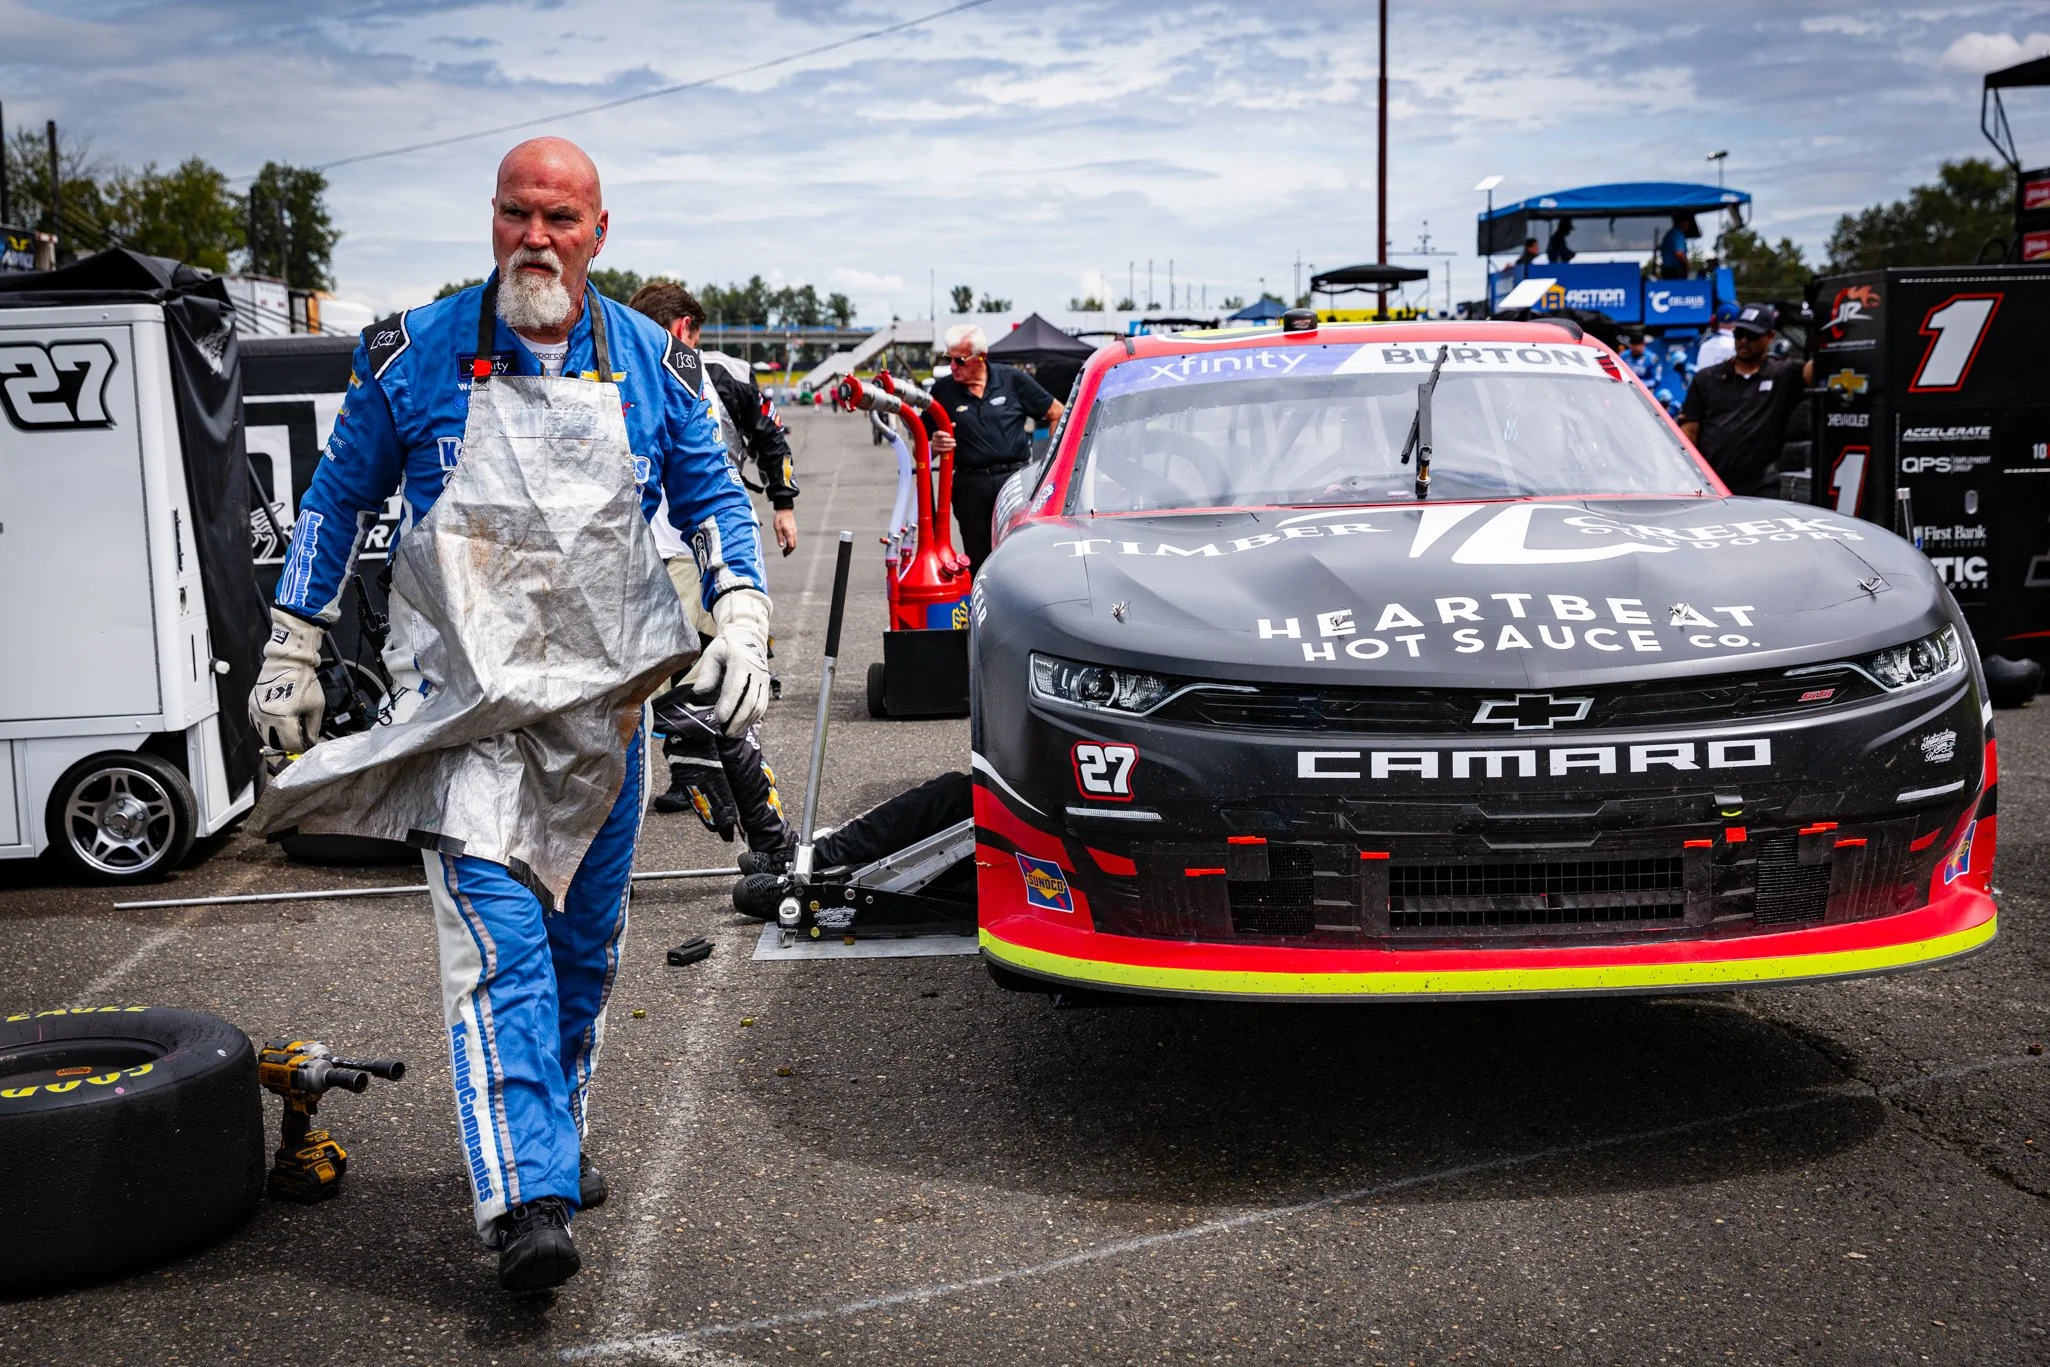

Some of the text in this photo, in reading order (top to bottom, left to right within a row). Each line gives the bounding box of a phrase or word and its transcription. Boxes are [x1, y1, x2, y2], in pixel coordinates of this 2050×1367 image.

[370, 330, 401, 350] K1
[1381, 347, 1589, 367] BURTON
[1908, 293, 2004, 393] 1
[675, 351, 697, 369] K1
[1150, 350, 1308, 382] xfinity
[0, 340, 117, 428] 27
[1902, 426, 1991, 438] ACCELERATE
[1827, 445, 1871, 517] 1
[1901, 457, 1952, 473] QPS
[1053, 516, 1857, 557] TIMBER CREEK
[1924, 524, 1987, 541] First Bank
[1257, 593, 1755, 639] HEARTBEAT
[1302, 624, 1761, 662] HOT SAUCE CO.
[1076, 744, 1136, 794] 27
[1297, 738, 1772, 779] CAMARO
[1027, 873, 1065, 893] SUNOCO
[451, 1021, 494, 1203] KauligCompanies
